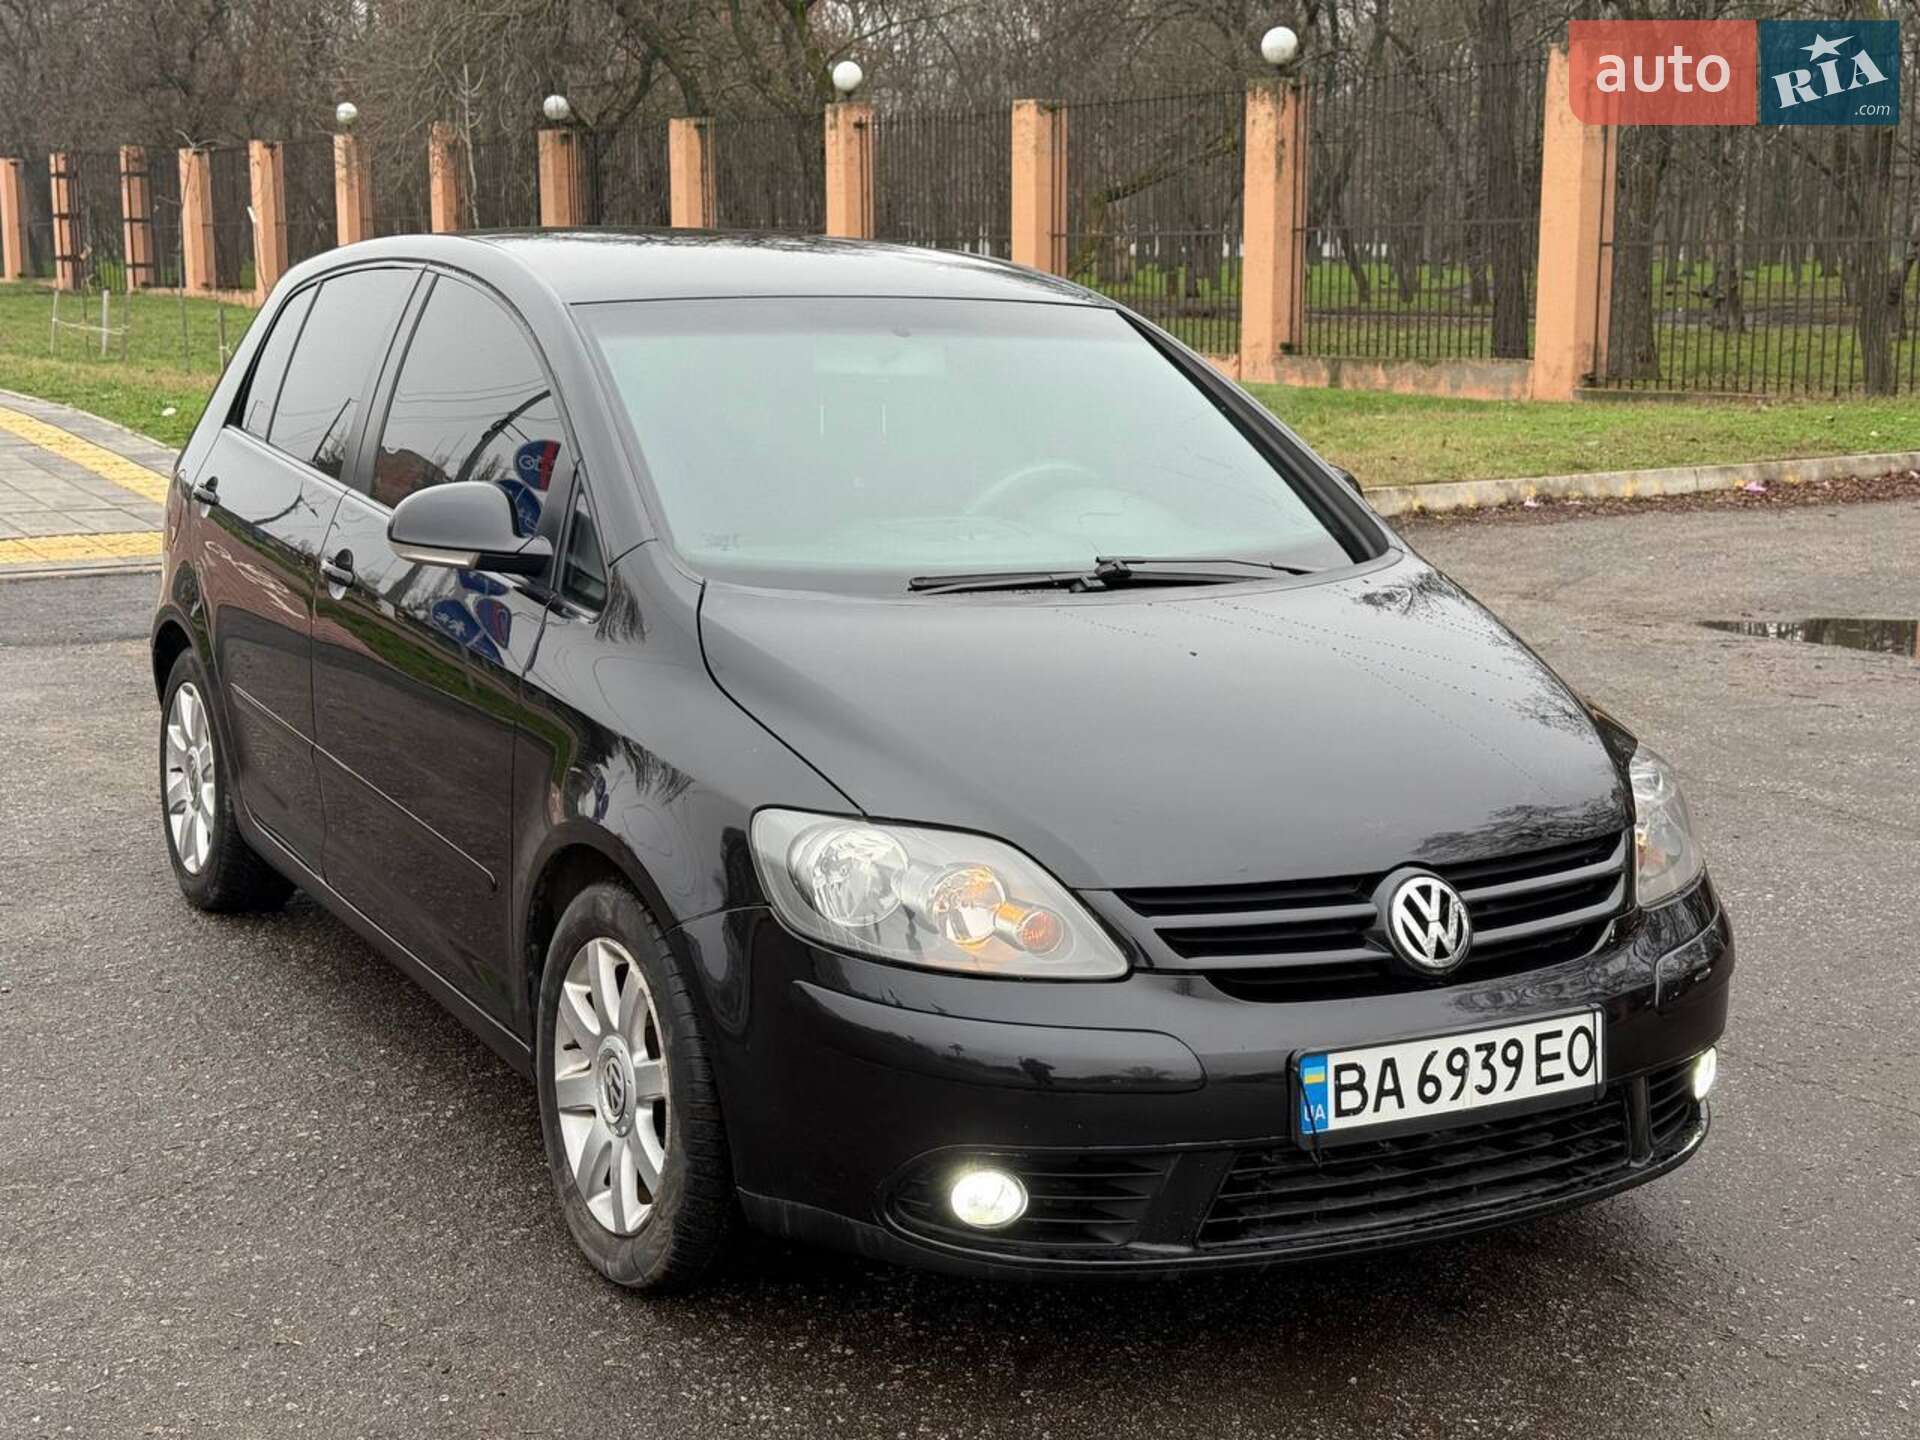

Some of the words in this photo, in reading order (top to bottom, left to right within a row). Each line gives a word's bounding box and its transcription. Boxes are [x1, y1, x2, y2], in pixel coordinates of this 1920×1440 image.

[1396, 880, 1466, 964] VW
[1334, 1056, 1405, 1118] BA
[1417, 1037, 1524, 1104] 6939
[1535, 1025, 1594, 1086] EO
